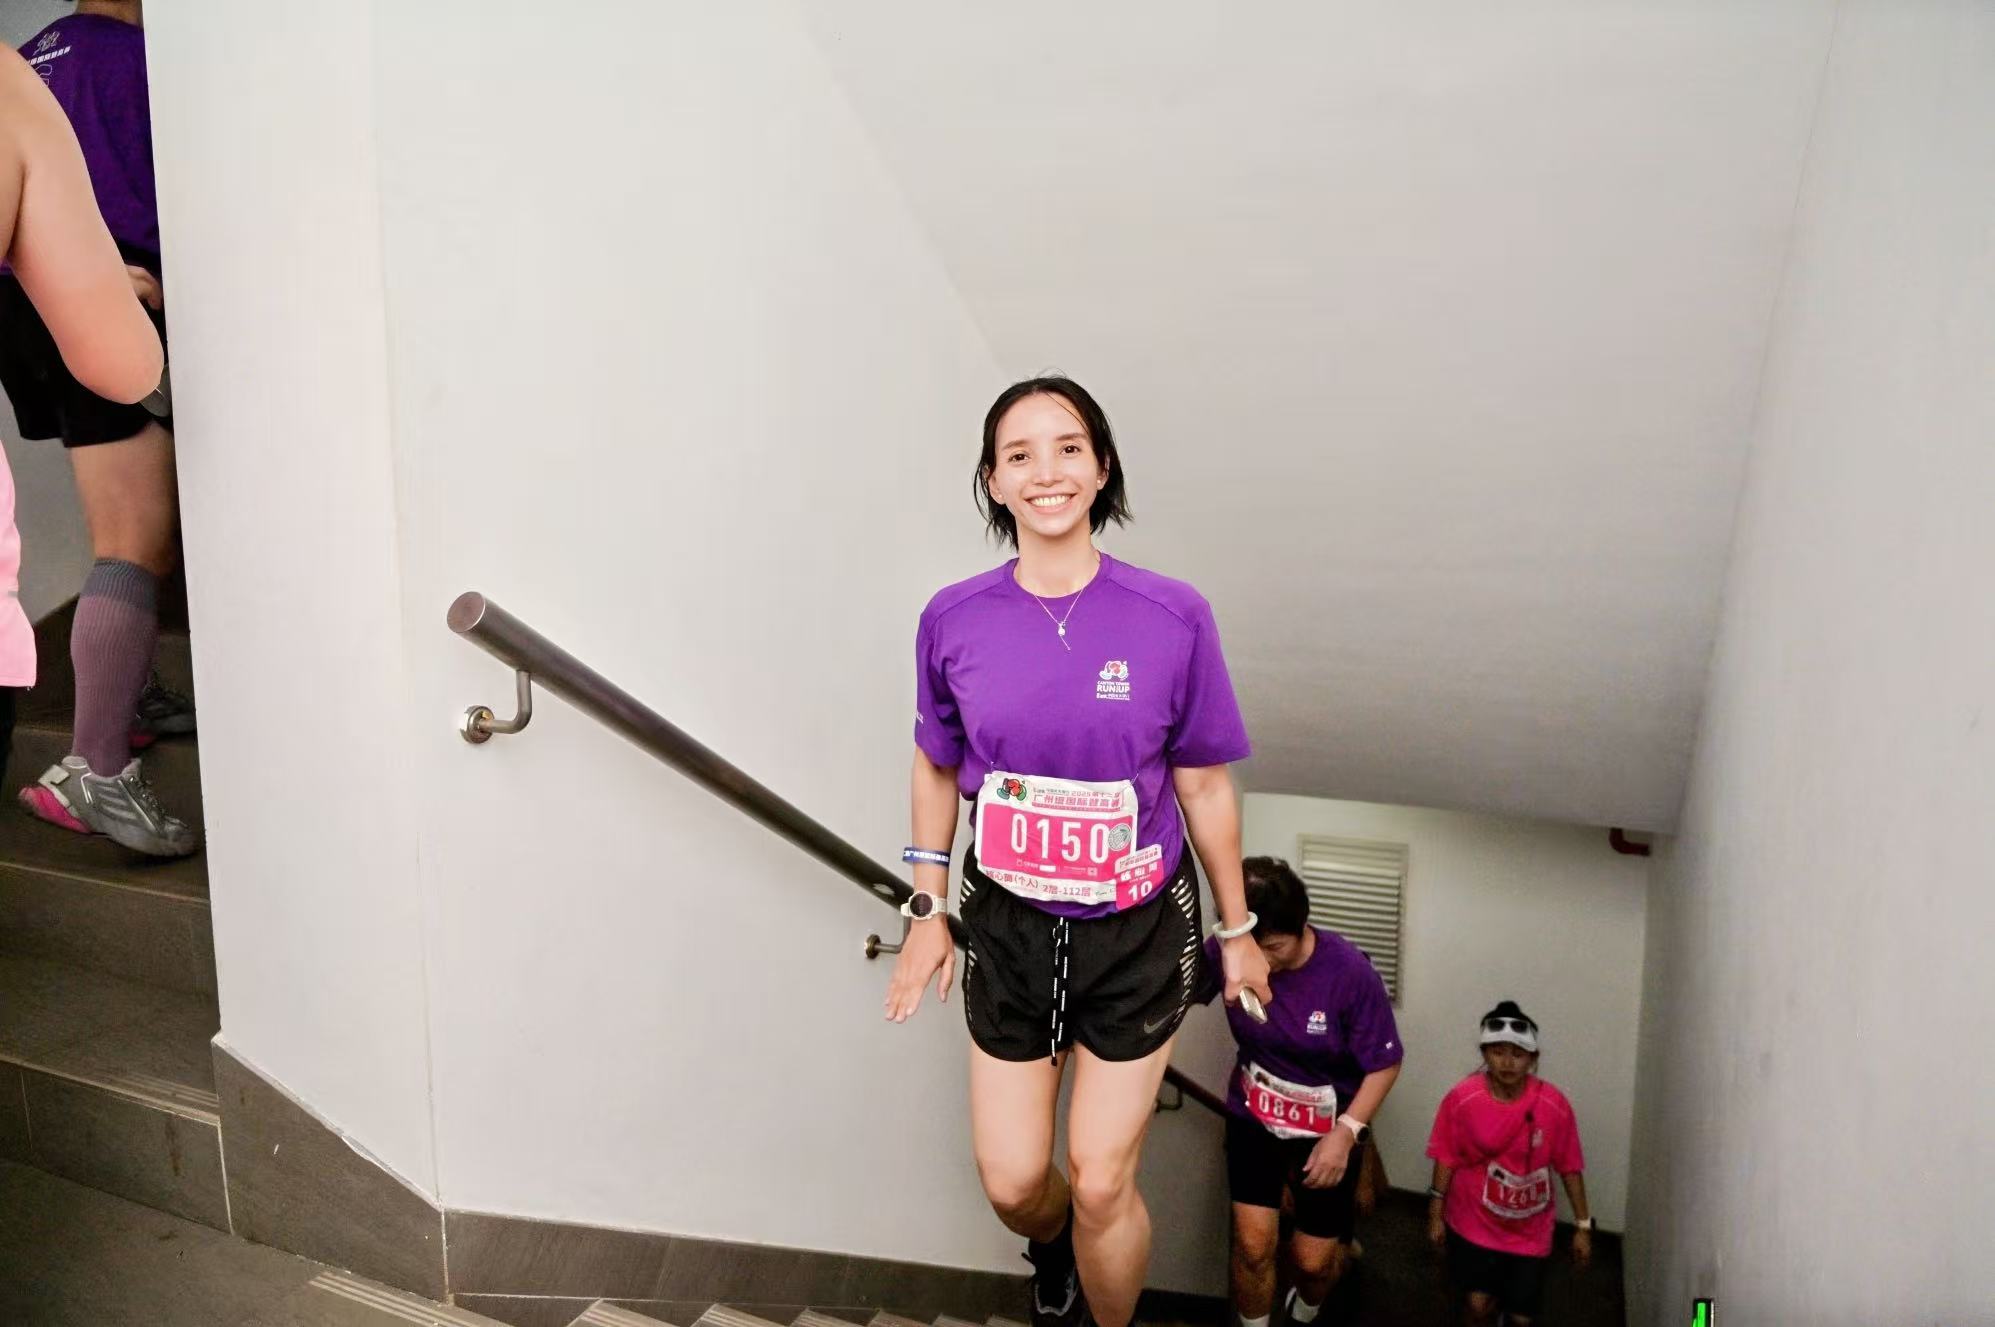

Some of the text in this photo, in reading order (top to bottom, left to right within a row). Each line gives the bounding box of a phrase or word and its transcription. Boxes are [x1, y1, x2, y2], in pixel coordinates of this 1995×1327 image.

[1011, 813, 1110, 864] 0150
[1128, 880, 1153, 902] 10
[1259, 1092, 1314, 1125] 0861
